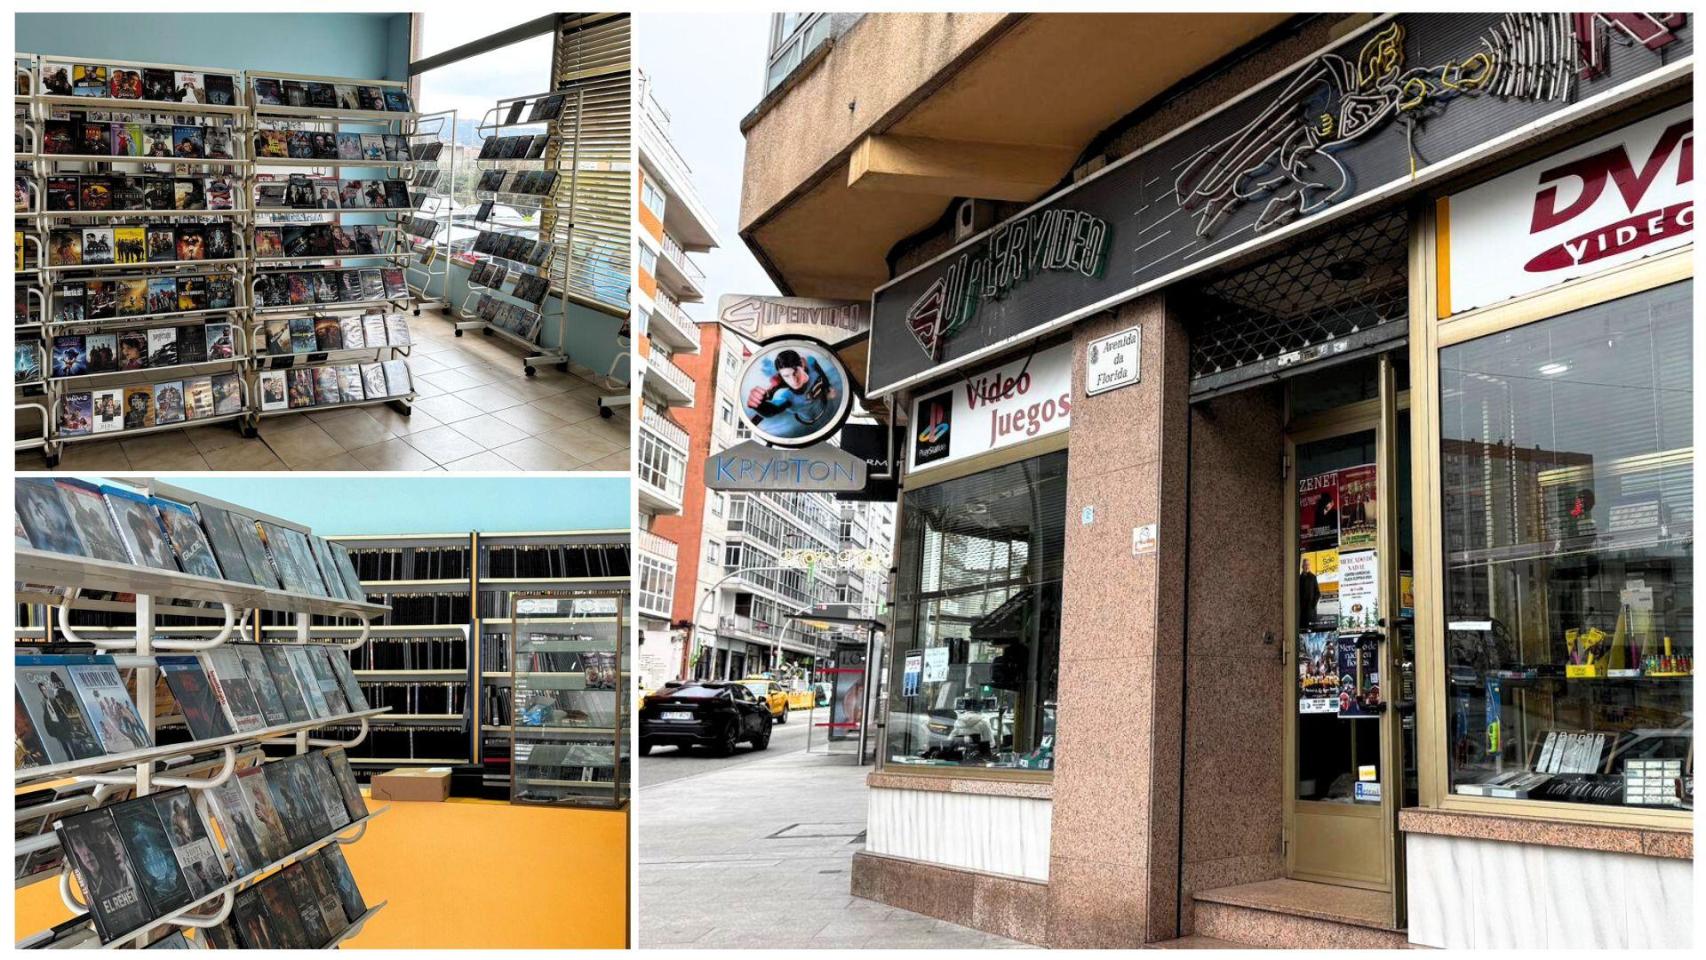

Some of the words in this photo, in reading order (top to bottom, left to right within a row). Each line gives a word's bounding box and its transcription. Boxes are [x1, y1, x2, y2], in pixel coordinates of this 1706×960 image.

[721, 297, 860, 337] SUPERVIDEO
[1103, 333, 1136, 352] Avenida
[1113, 353, 1124, 365] da
[1096, 367, 1128, 386] Florida
[966, 371, 1031, 411] Video
[989, 392, 1072, 448] Juegos
[716, 455, 855, 483] KRYPTON
[1299, 473, 1338, 493] ZENET
